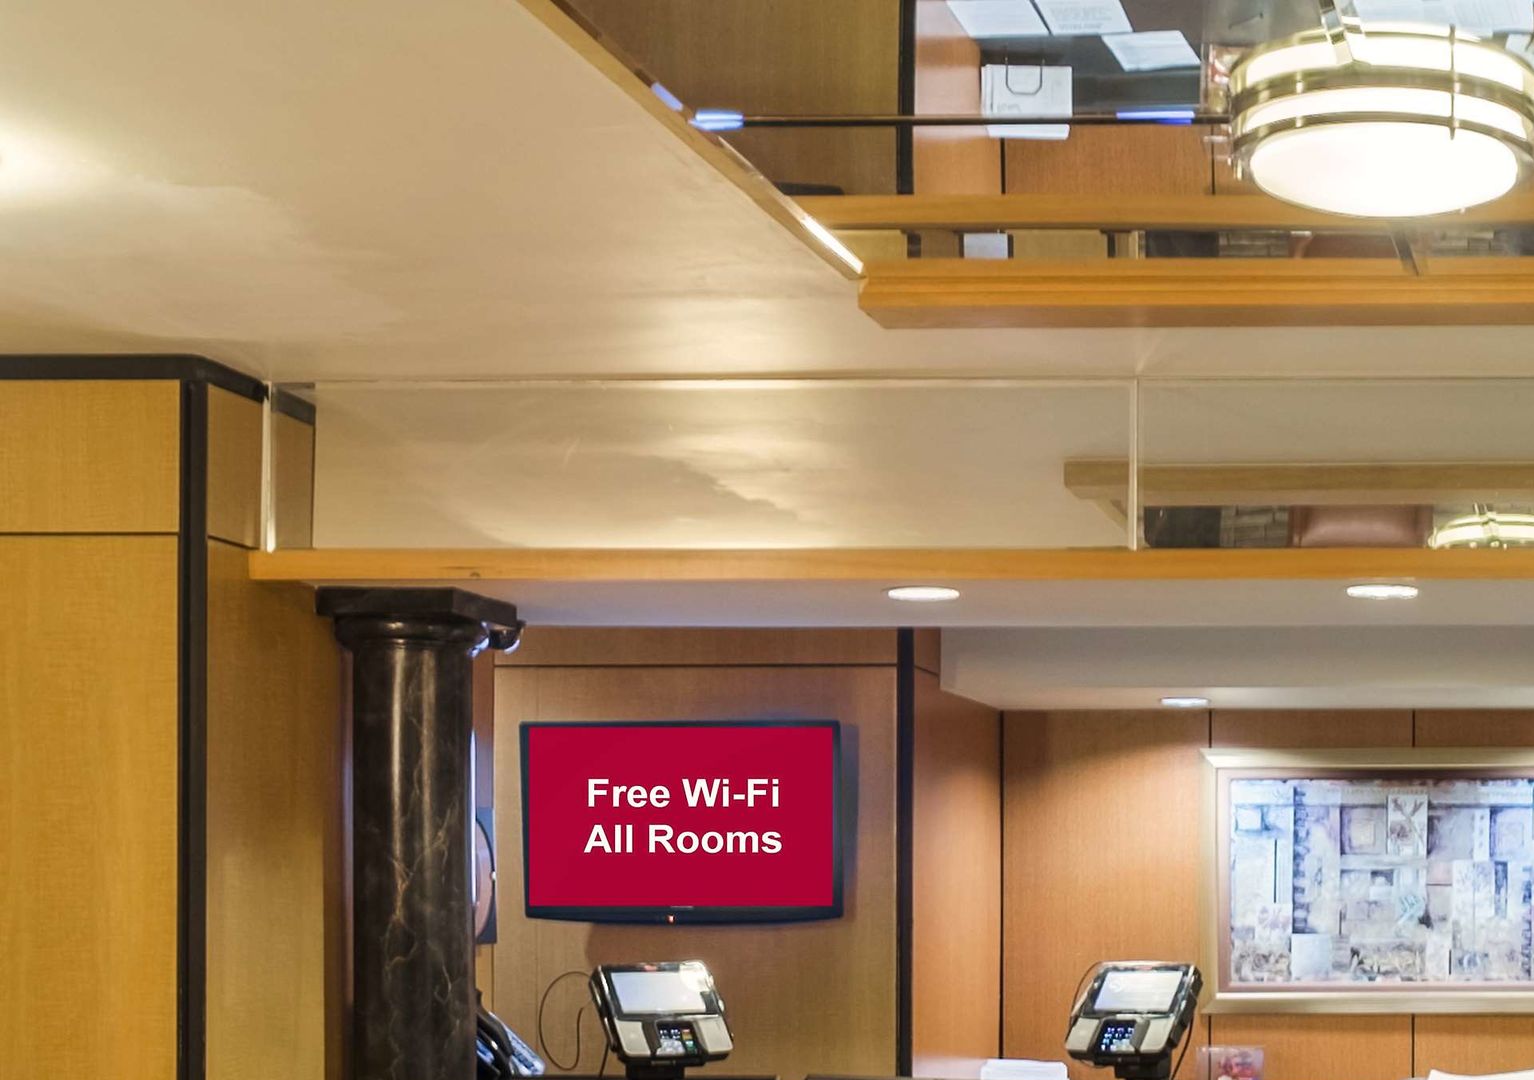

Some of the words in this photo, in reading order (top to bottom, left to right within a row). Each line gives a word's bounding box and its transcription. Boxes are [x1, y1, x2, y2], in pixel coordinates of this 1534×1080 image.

[587, 778, 671, 808] Free
[682, 778, 780, 808] Wi-Fi
[584, 824, 634, 854] All
[648, 824, 783, 854] Rooms
